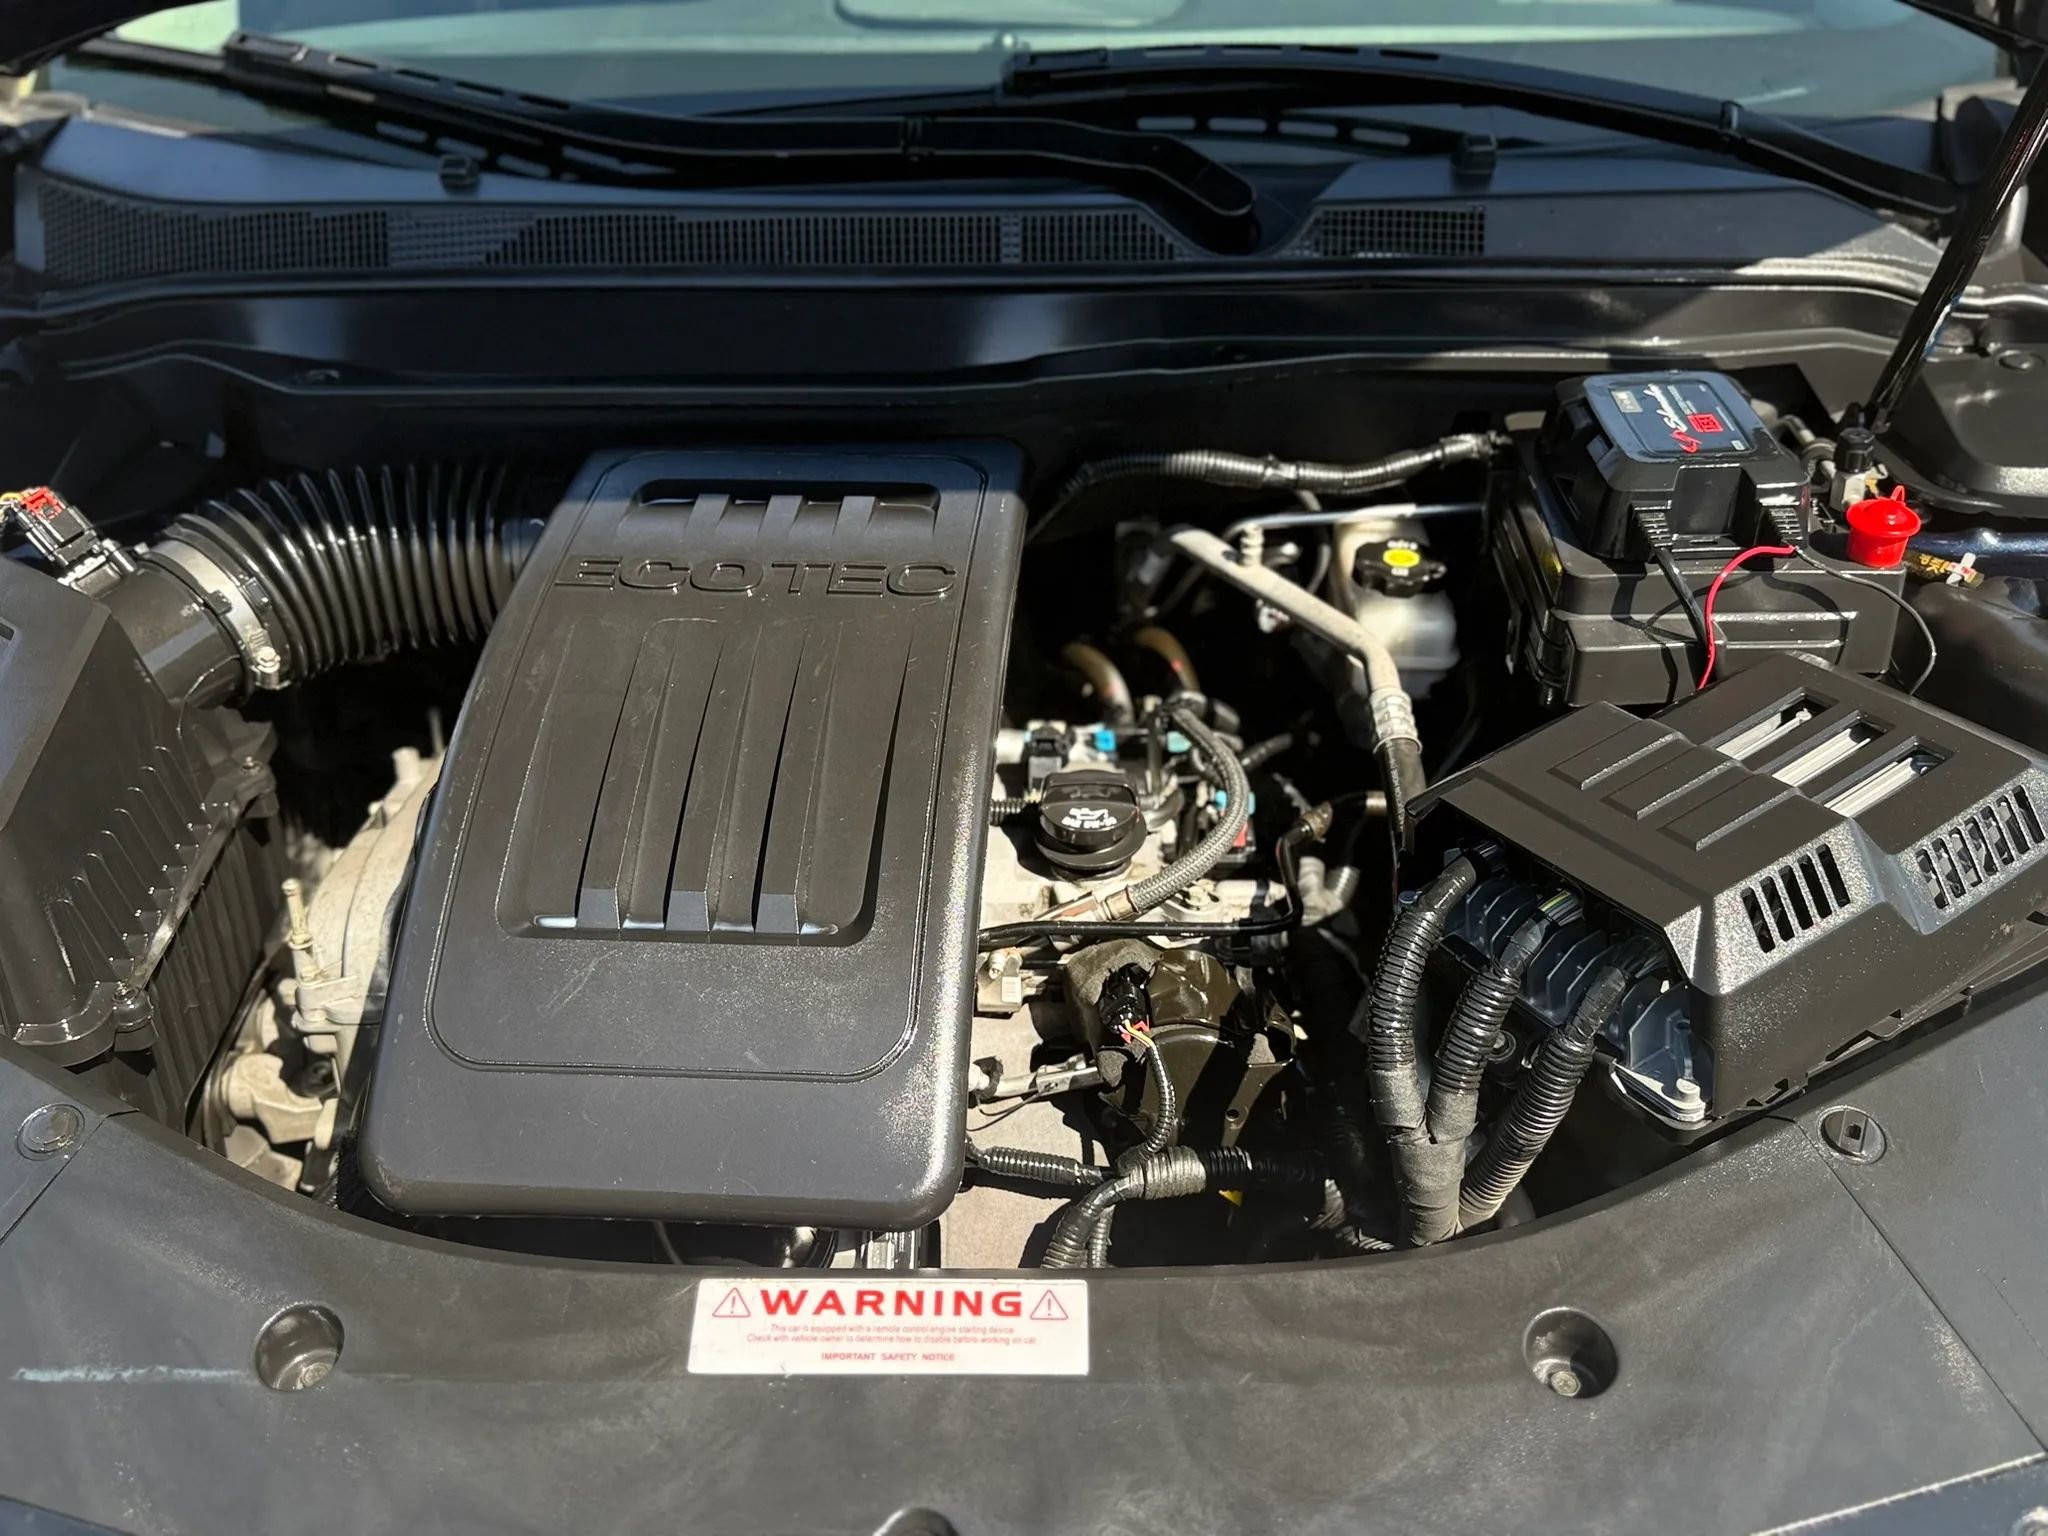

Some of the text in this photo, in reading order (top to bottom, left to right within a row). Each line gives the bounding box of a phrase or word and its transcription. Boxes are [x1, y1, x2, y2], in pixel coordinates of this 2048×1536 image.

[555, 557, 957, 596] ECOTEC
[759, 1289, 1022, 1317] WARNING
[771, 1323, 786, 1333] This
[788, 1325, 801, 1333] car
[810, 1324, 847, 1335] equipped
[848, 1325, 864, 1334] with
[873, 1325, 900, 1334] remote
[902, 1325, 929, 1334] control
[930, 1326, 957, 1336] engine
[958, 1325, 987, 1336] starting
[746, 1333, 771, 1343] Check
[773, 1333, 790, 1343] with
[791, 1333, 818, 1343] vehicle
[820, 1335, 844, 1343] owner
[846, 1334, 854, 1343] to
[855, 1334, 896, 1344] determine
[896, 1334, 912, 1344] how
[914, 1335, 922, 1344] to
[924, 1335, 951, 1344] disable
[953, 1335, 978, 1344] before
[980, 1335, 1010, 1346] working
[821, 1353, 956, 1361] IMPORTANT SAFETY NOTICE
